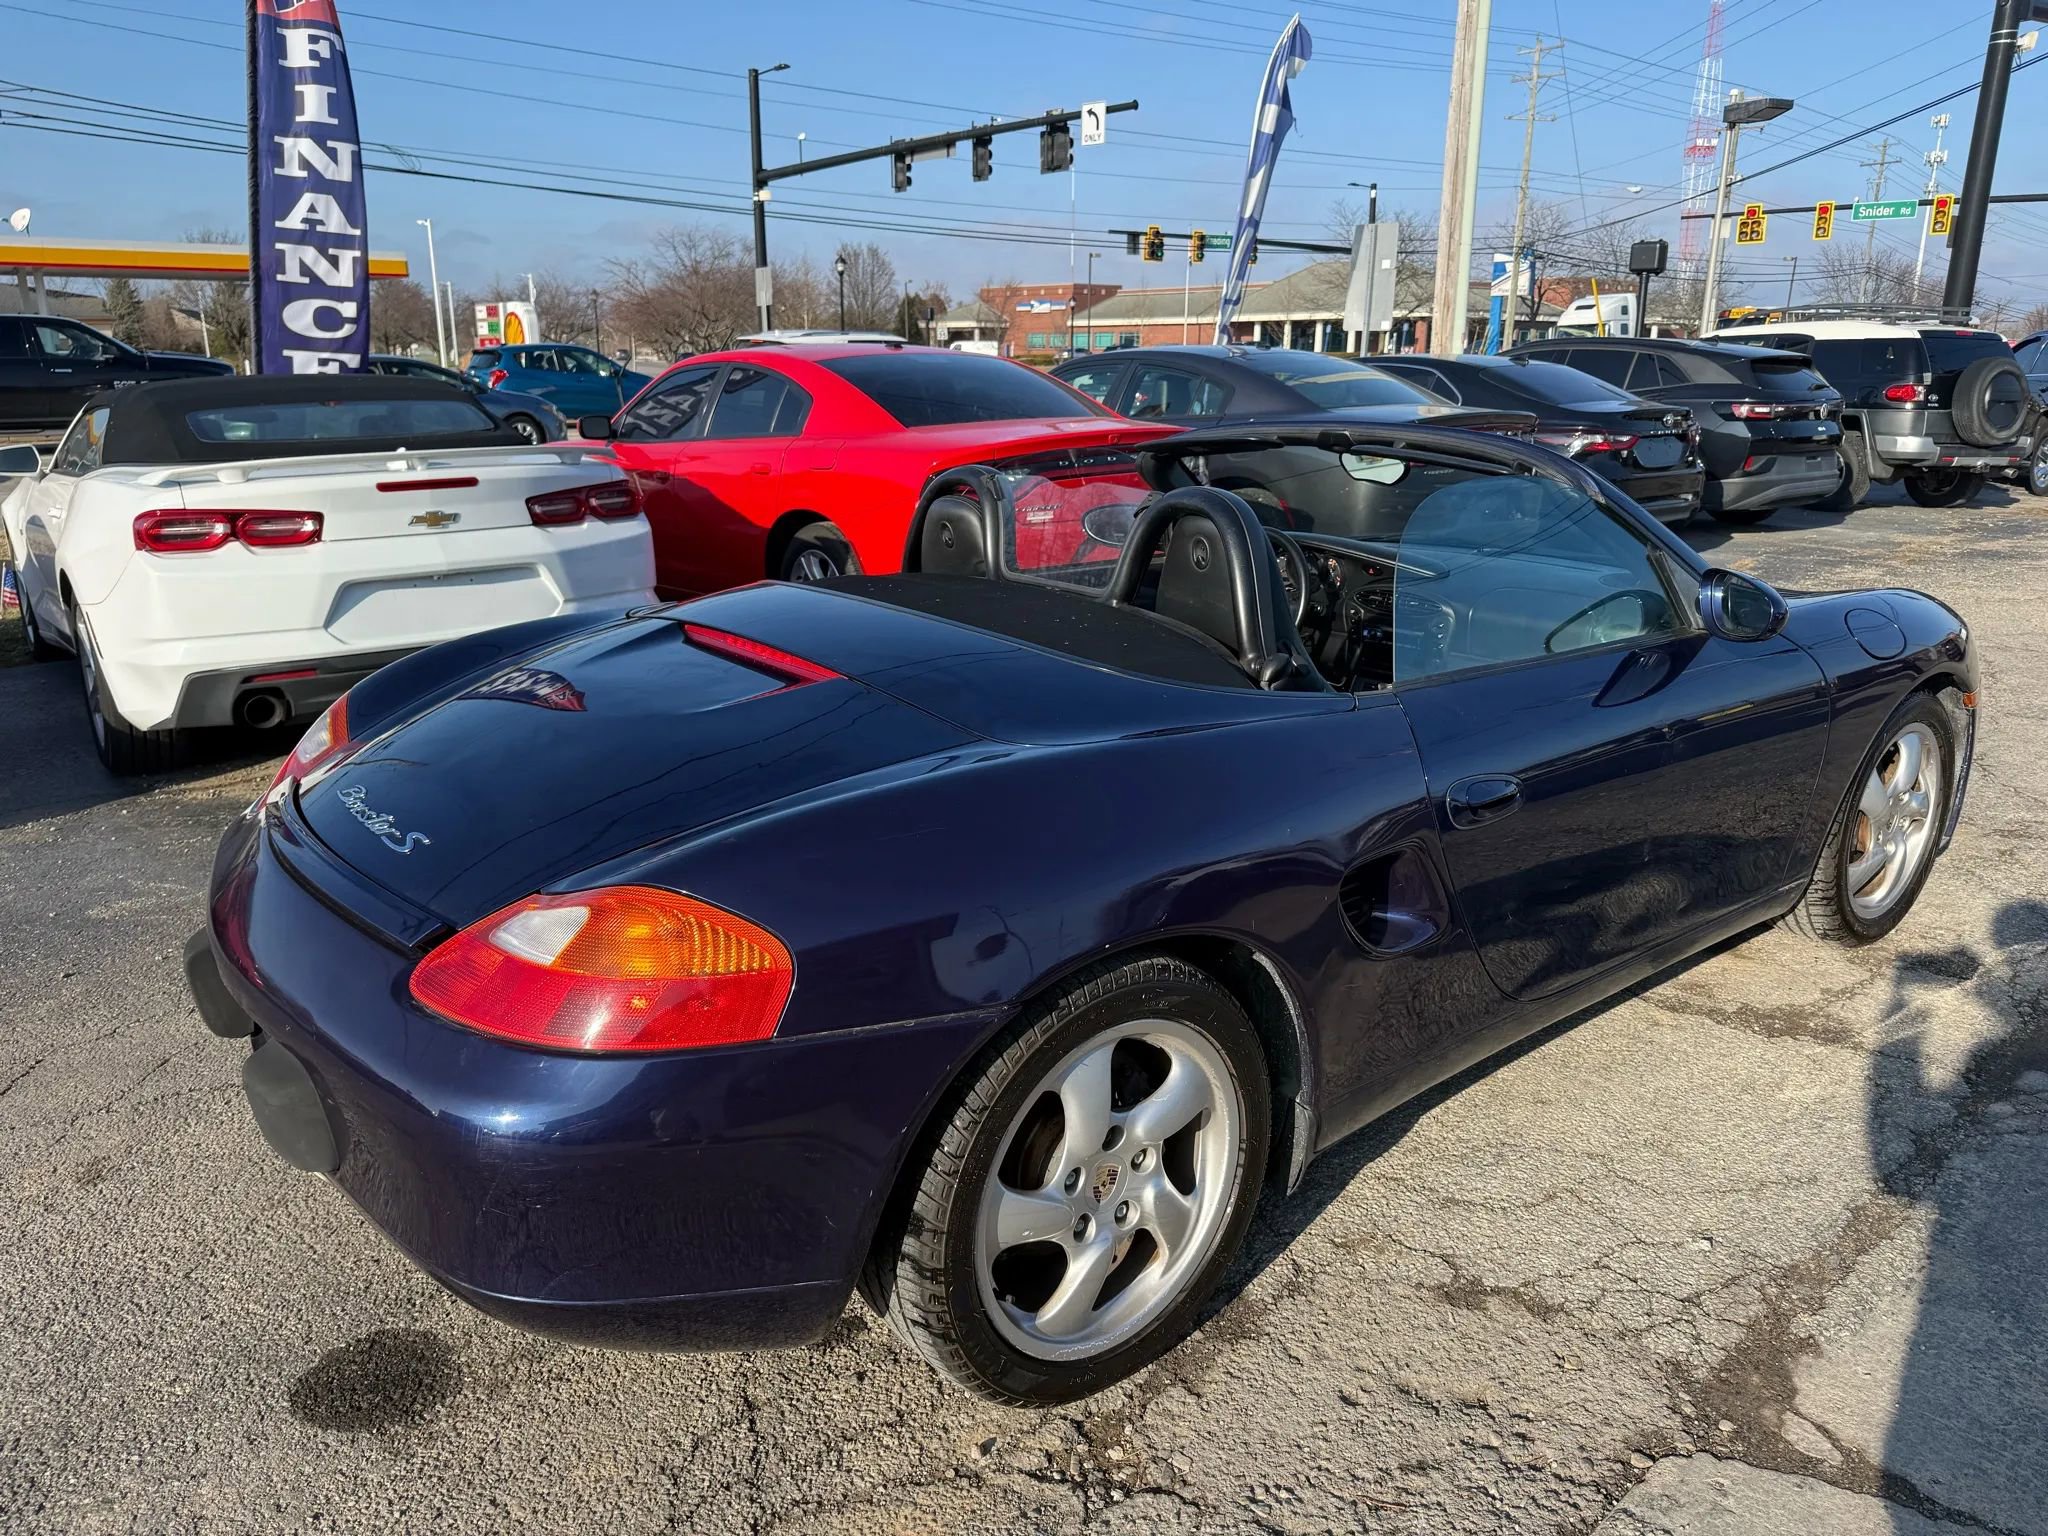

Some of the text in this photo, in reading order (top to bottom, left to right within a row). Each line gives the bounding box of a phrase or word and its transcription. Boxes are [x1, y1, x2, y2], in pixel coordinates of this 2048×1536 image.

[1084, 133, 1102, 142] ONLY
[274, 28, 362, 374] FINANCE
[1858, 206, 1912, 217] Snider Rd
[337, 784, 431, 854] Boxster S
